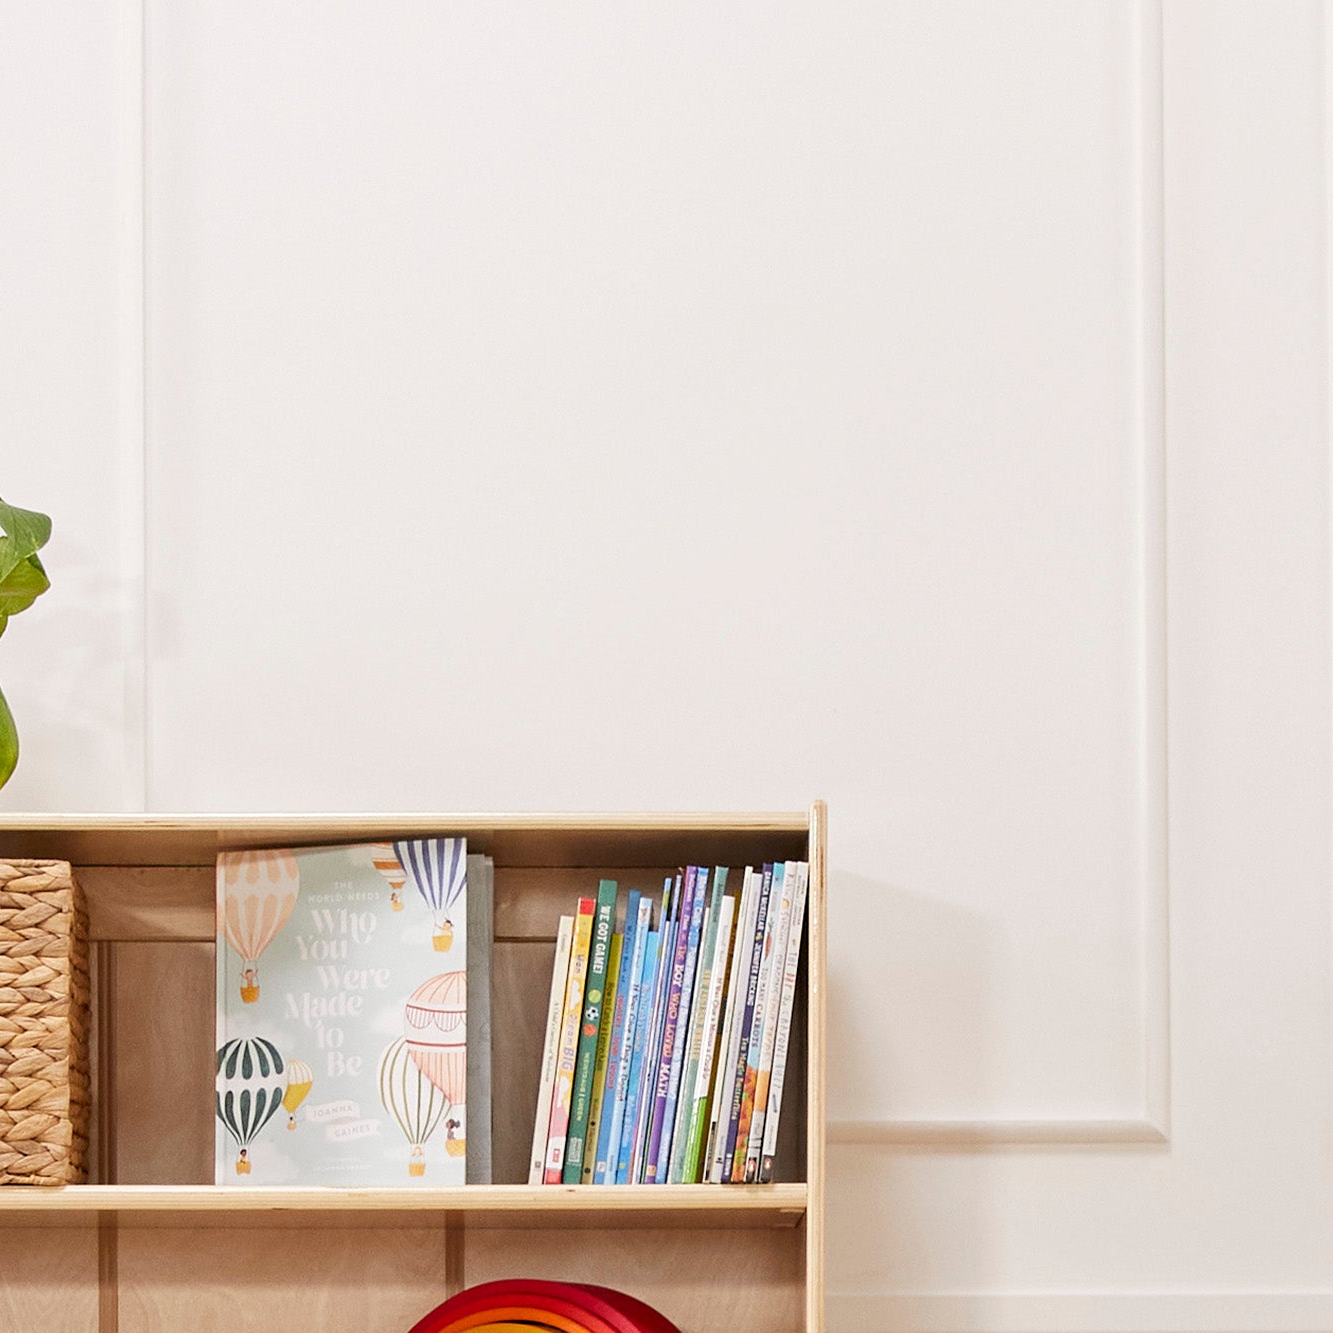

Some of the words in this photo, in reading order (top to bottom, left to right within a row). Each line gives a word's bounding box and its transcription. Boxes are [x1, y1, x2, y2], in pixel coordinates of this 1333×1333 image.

[311, 909, 376, 943] Who
[600, 906, 611, 921] WE
[597, 923, 608, 941] GOT
[296, 935, 348, 960] You
[593, 943, 605, 974] GAME!
[317, 965, 391, 990] Were
[674, 964, 684, 987] BOY
[285, 992, 362, 1029] Made
[669, 992, 680, 1019] WHO
[316, 1019, 343, 1048] To
[752, 1004, 762, 1047] CARROTS
[664, 1024, 675, 1057] LOVED
[327, 1051, 361, 1077] Be
[562, 1047, 575, 1070] BIG
[657, 1063, 670, 1097] MATH
[314, 1106, 352, 1117] JOANNA
[335, 1125, 370, 1137] GAINES
